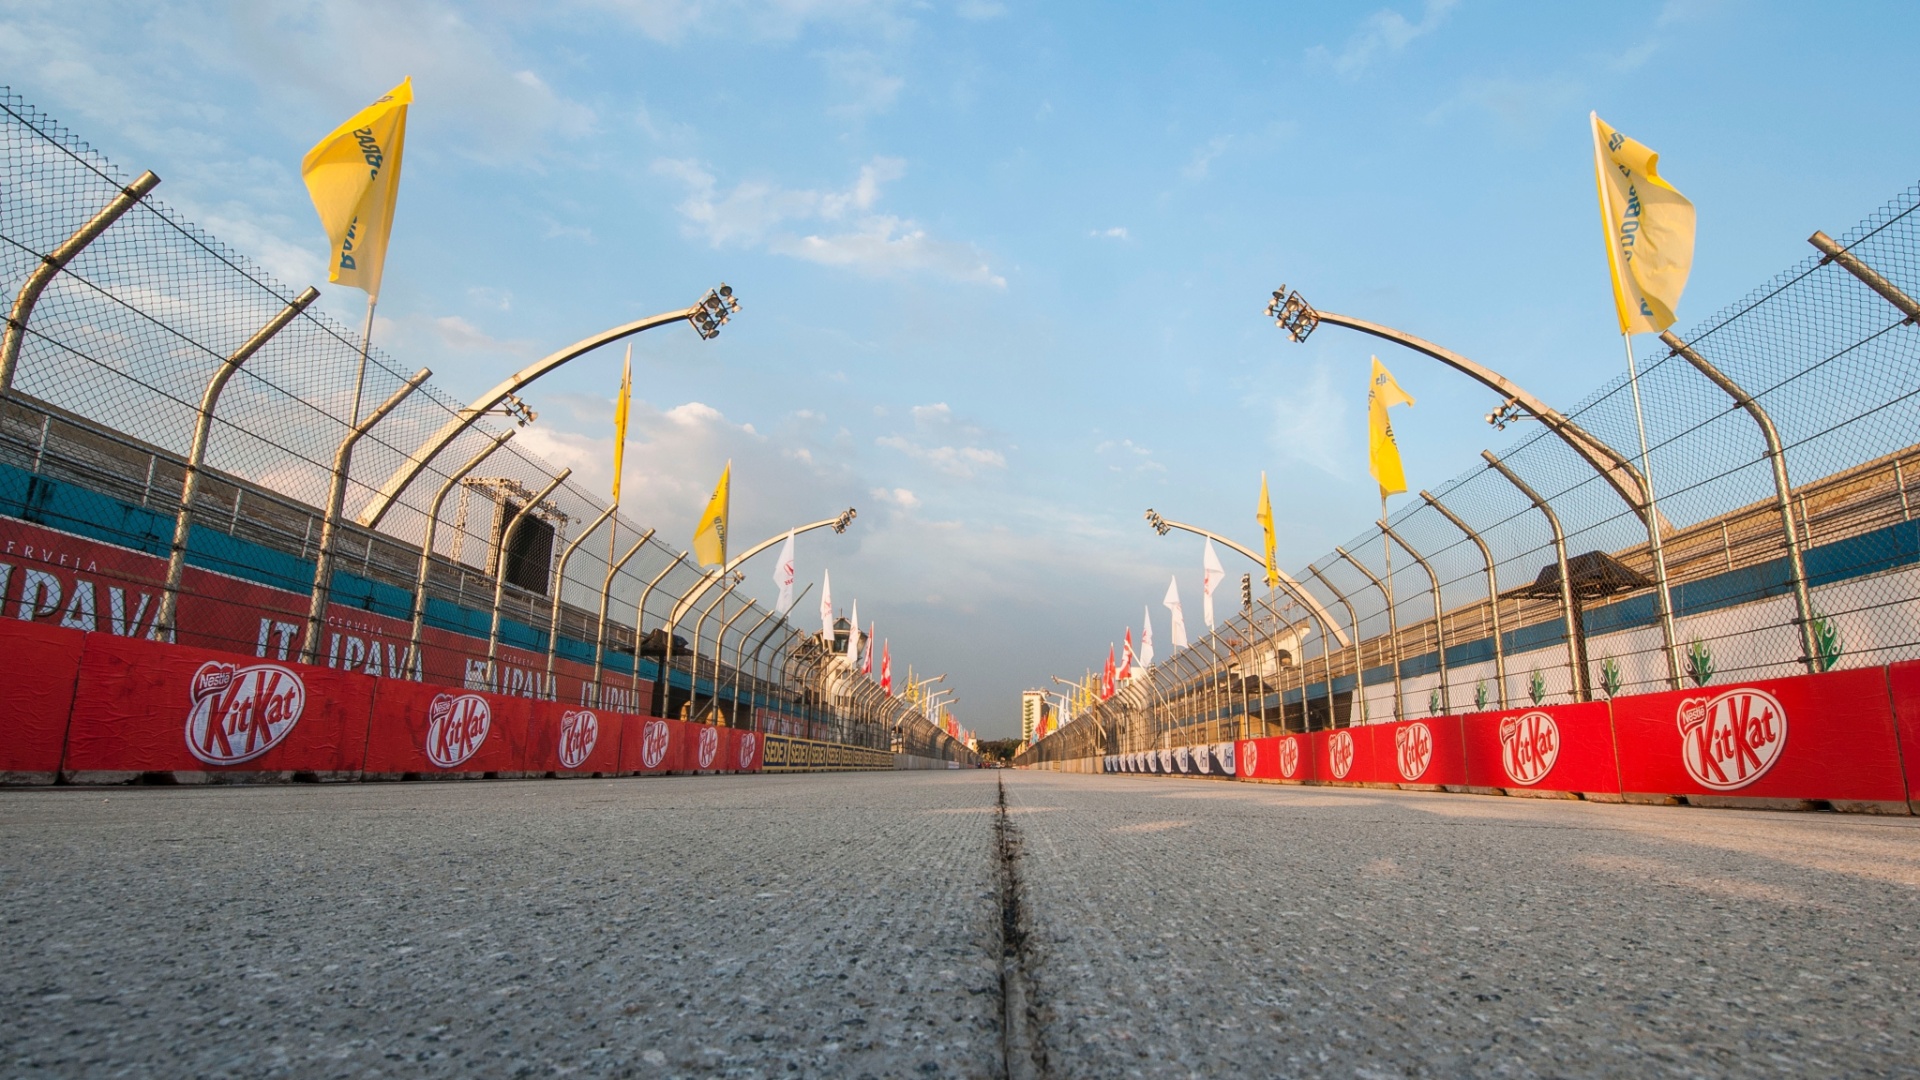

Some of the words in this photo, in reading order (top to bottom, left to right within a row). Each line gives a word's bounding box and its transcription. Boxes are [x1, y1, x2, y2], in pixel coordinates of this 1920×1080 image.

[256, 618, 424, 683] ITIPAVA
[203, 671, 296, 756] KitKat
[436, 700, 486, 761] KitKat
[1695, 696, 1776, 783] KitKat
[765, 740, 788, 763] SEDEX
[1510, 717, 1554, 779] KitKat
